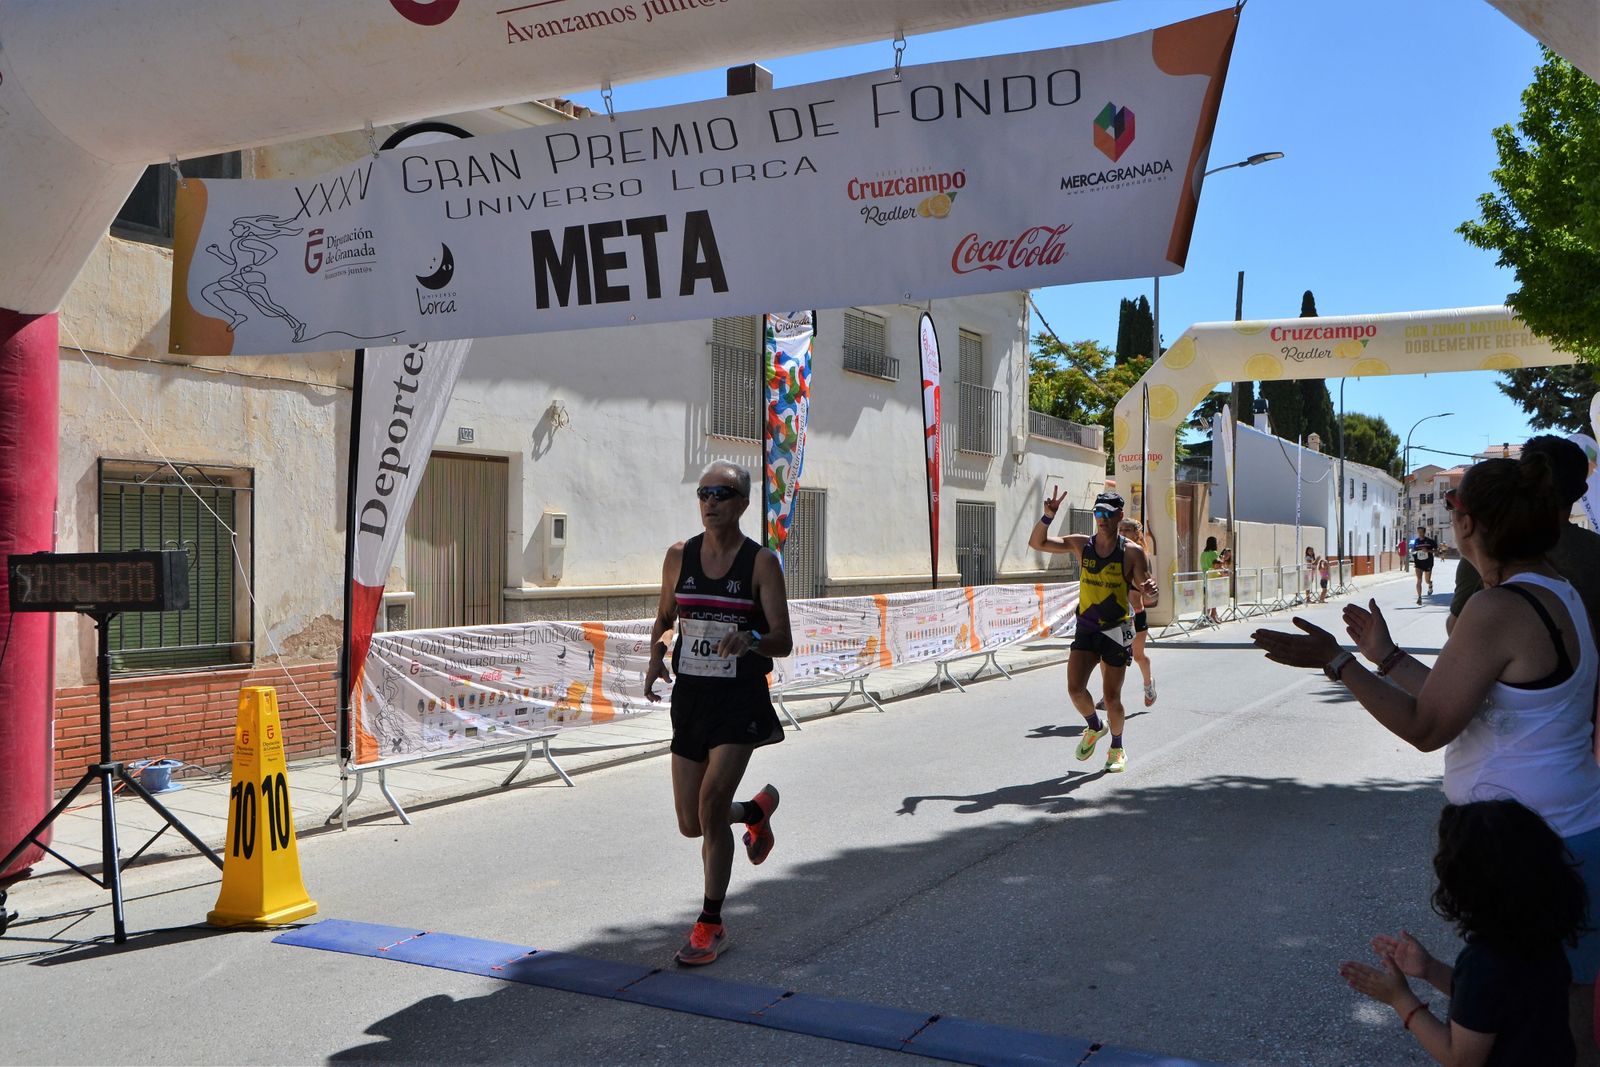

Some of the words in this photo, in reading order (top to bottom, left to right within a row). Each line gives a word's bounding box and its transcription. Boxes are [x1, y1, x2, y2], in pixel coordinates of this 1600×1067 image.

[507, 3, 637, 45] Avanzamos
[294, 162, 373, 220] XXXV
[402, 149, 522, 194] GRAN
[545, 117, 739, 174] PREMIO
[769, 100, 840, 144] DE
[871, 69, 1082, 128] FONDO
[445, 178, 643, 220] UNIVERSO
[672, 156, 818, 191] LORCA
[847, 170, 967, 201] Cruzcampo
[1060, 159, 1174, 191] MERCAGRANADA
[860, 204, 918, 226] Radler
[326, 227, 374, 249] Diputación
[334, 243, 376, 262] Granada
[951, 222, 1074, 275] Coca-Cola
[530, 209, 729, 310] META
[1270, 321, 1378, 342] Cruzcampo
[1404, 324, 1428, 338] CON
[1432, 322, 1466, 337] ZUMO
[1405, 335, 1490, 354] DOBLEMENTE
[1281, 346, 1332, 363] Radler
[452, 634, 498, 653] PREMIO
[522, 628, 559, 646] FONDO
[231, 780, 256, 860] 10
[261, 772, 290, 851] 10
